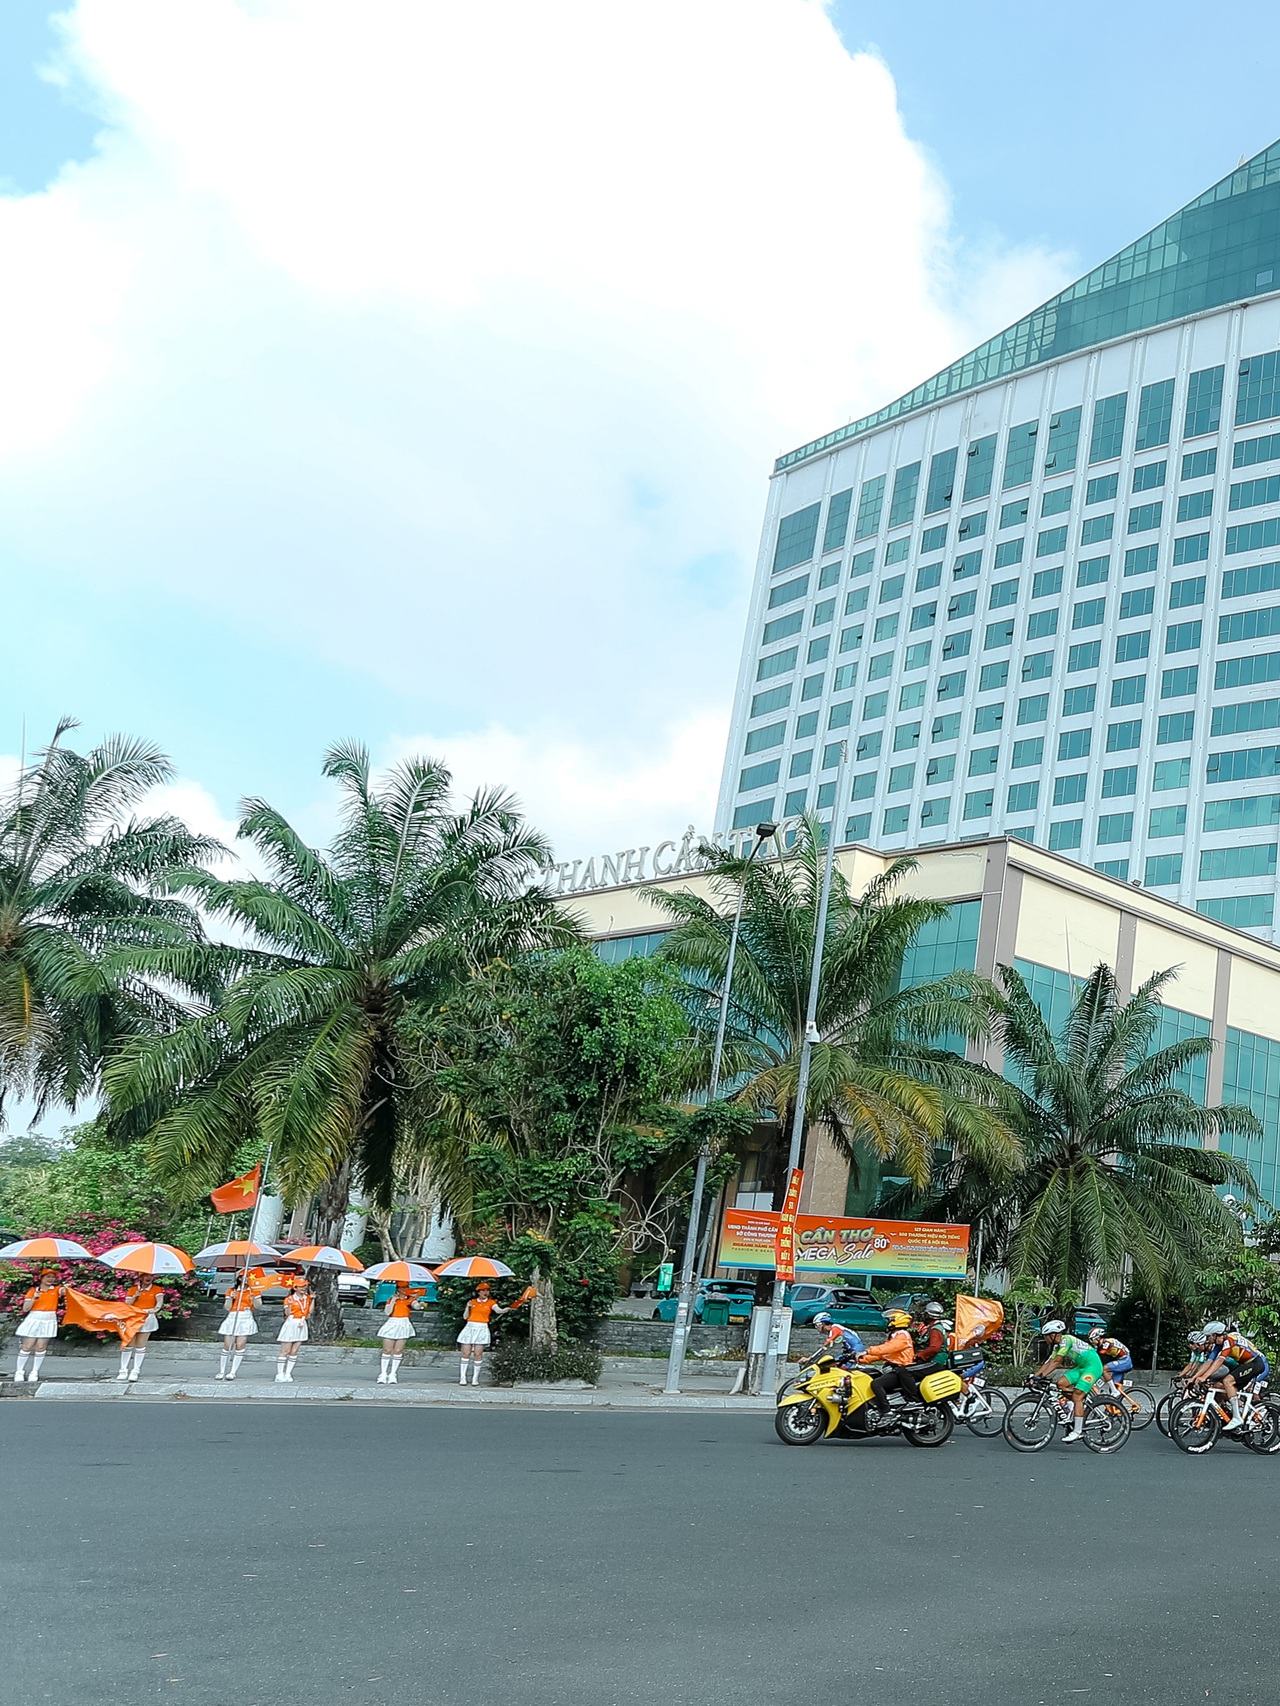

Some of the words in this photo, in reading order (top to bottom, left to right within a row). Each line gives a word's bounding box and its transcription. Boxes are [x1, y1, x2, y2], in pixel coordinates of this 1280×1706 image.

[800, 1227, 836, 1244] CẦN
[840, 1227, 875, 1243] THƠ
[795, 1247, 837, 1261] MEGA
[836, 1243, 875, 1265] Sale
